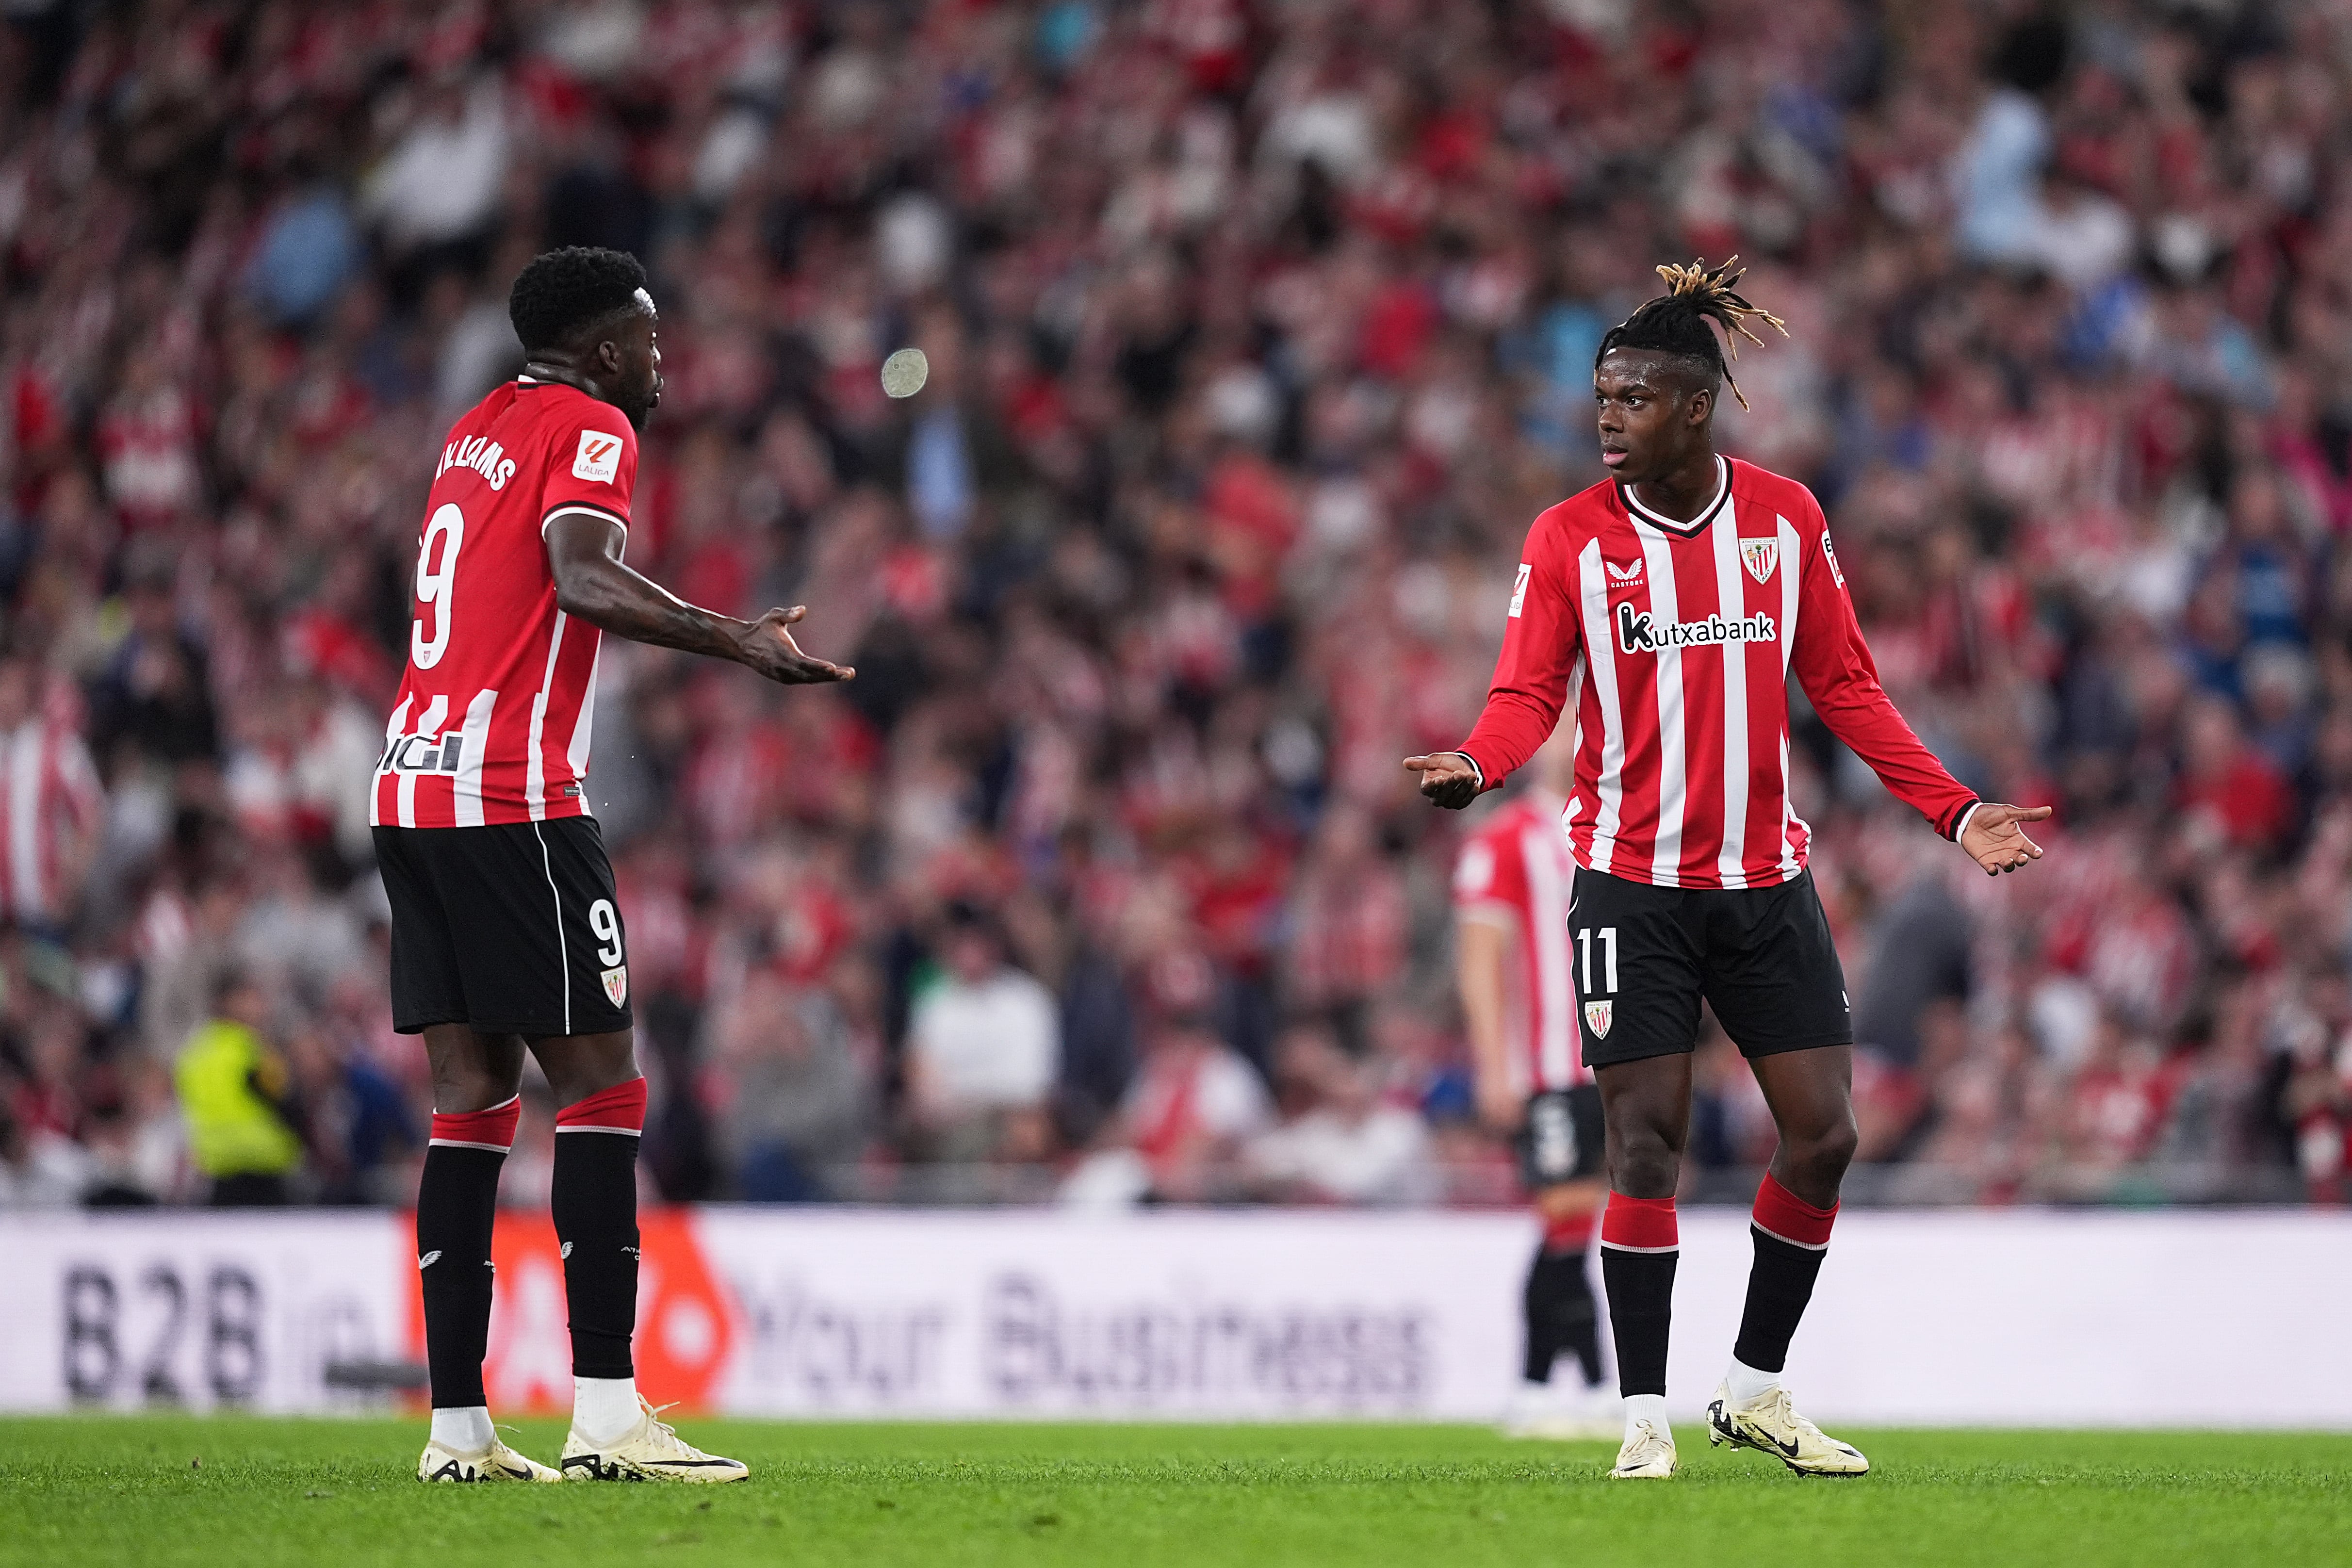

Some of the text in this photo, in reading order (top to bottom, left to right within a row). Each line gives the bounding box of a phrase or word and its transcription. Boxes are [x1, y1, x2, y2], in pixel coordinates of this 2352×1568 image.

[434, 435, 516, 491] ILLIAMS
[578, 464, 609, 476] LALIGA
[411, 503, 464, 670] 9
[1611, 579, 1643, 588] CASTORE
[1753, 569, 1770, 582] BILBAO
[1621, 605, 1772, 650] Kutxabank
[376, 736, 463, 771] IGI
[589, 899, 622, 966] 9
[1576, 927, 1618, 994] 11
[982, 1261, 1434, 1397] Business
